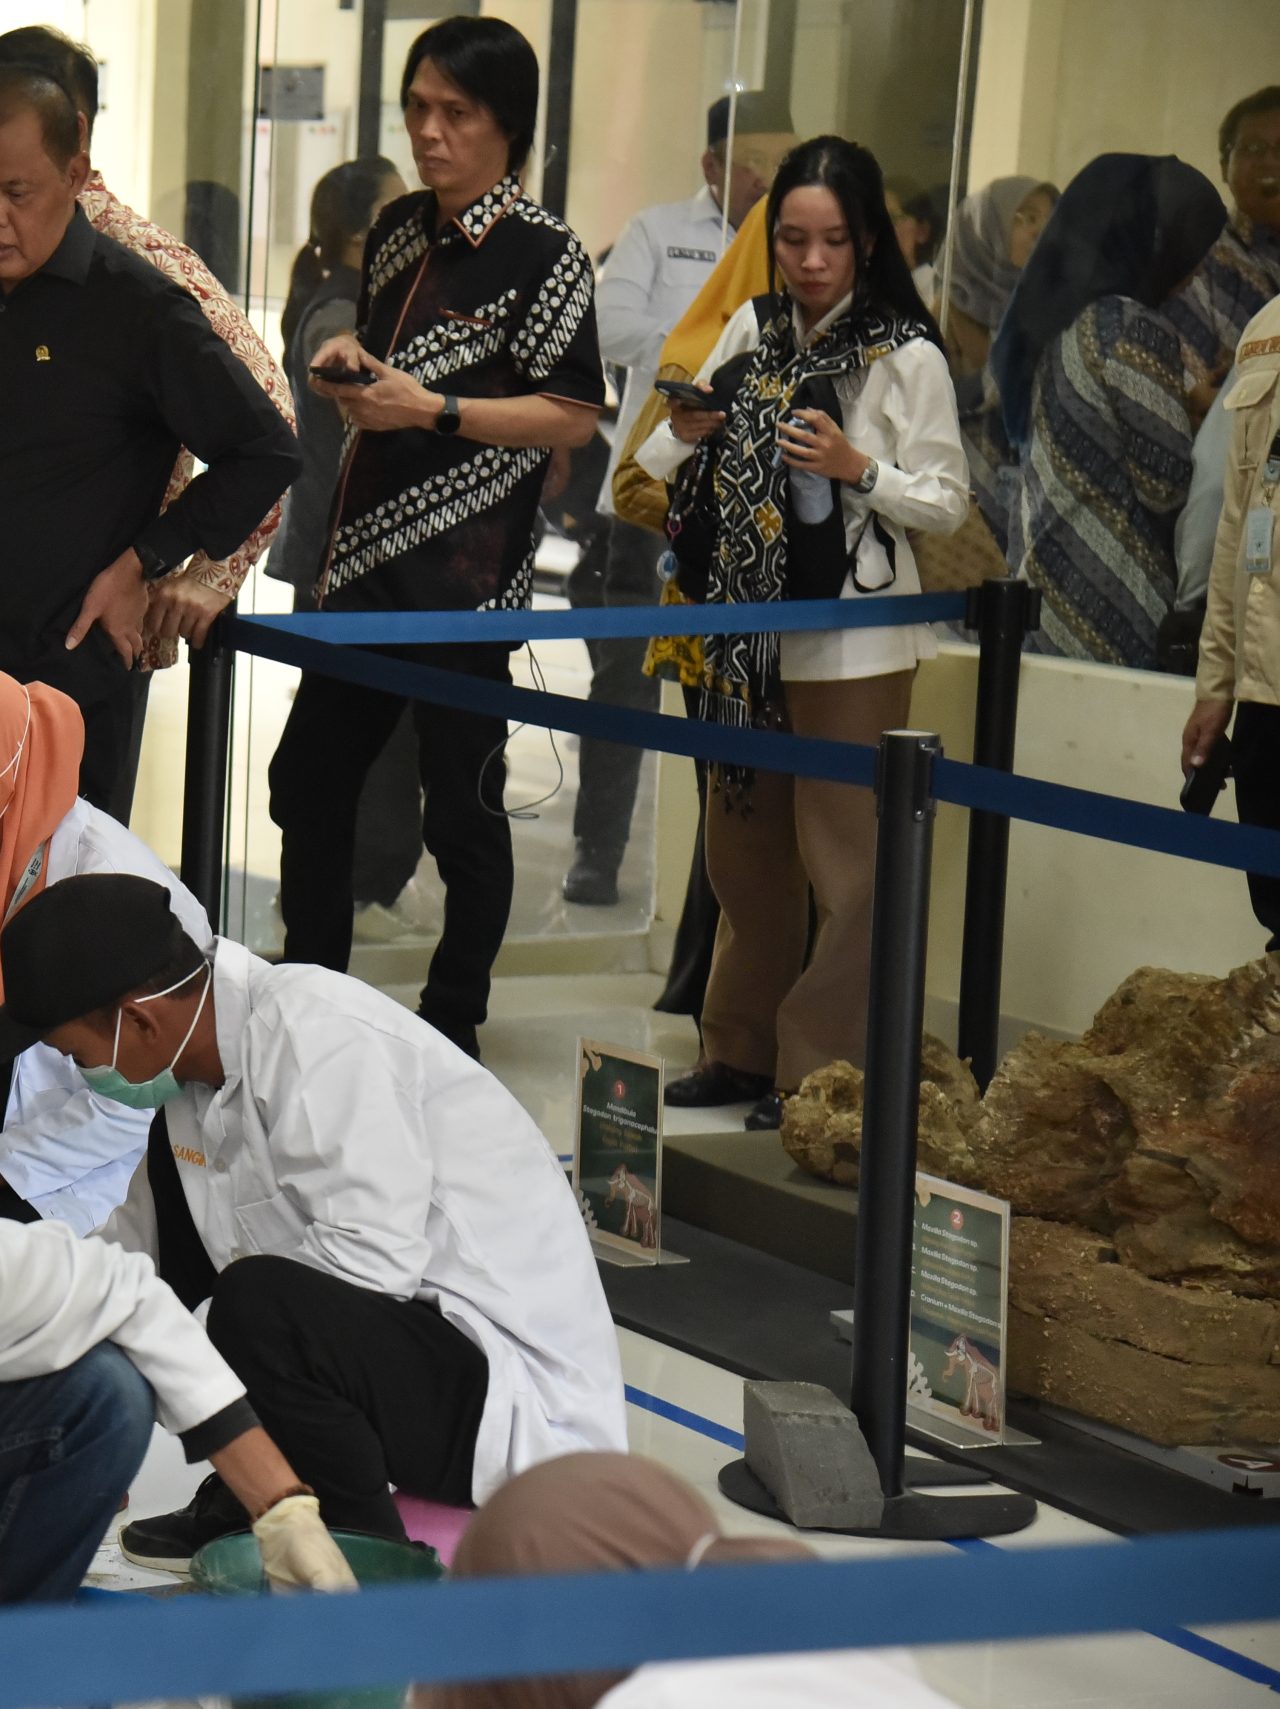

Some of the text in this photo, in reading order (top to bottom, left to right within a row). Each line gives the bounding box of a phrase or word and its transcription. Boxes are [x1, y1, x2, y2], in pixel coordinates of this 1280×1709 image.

[583, 1105, 612, 1120] Stegodon
[952, 1211, 961, 1224] 2
[920, 1293, 944, 1308] Cranium
